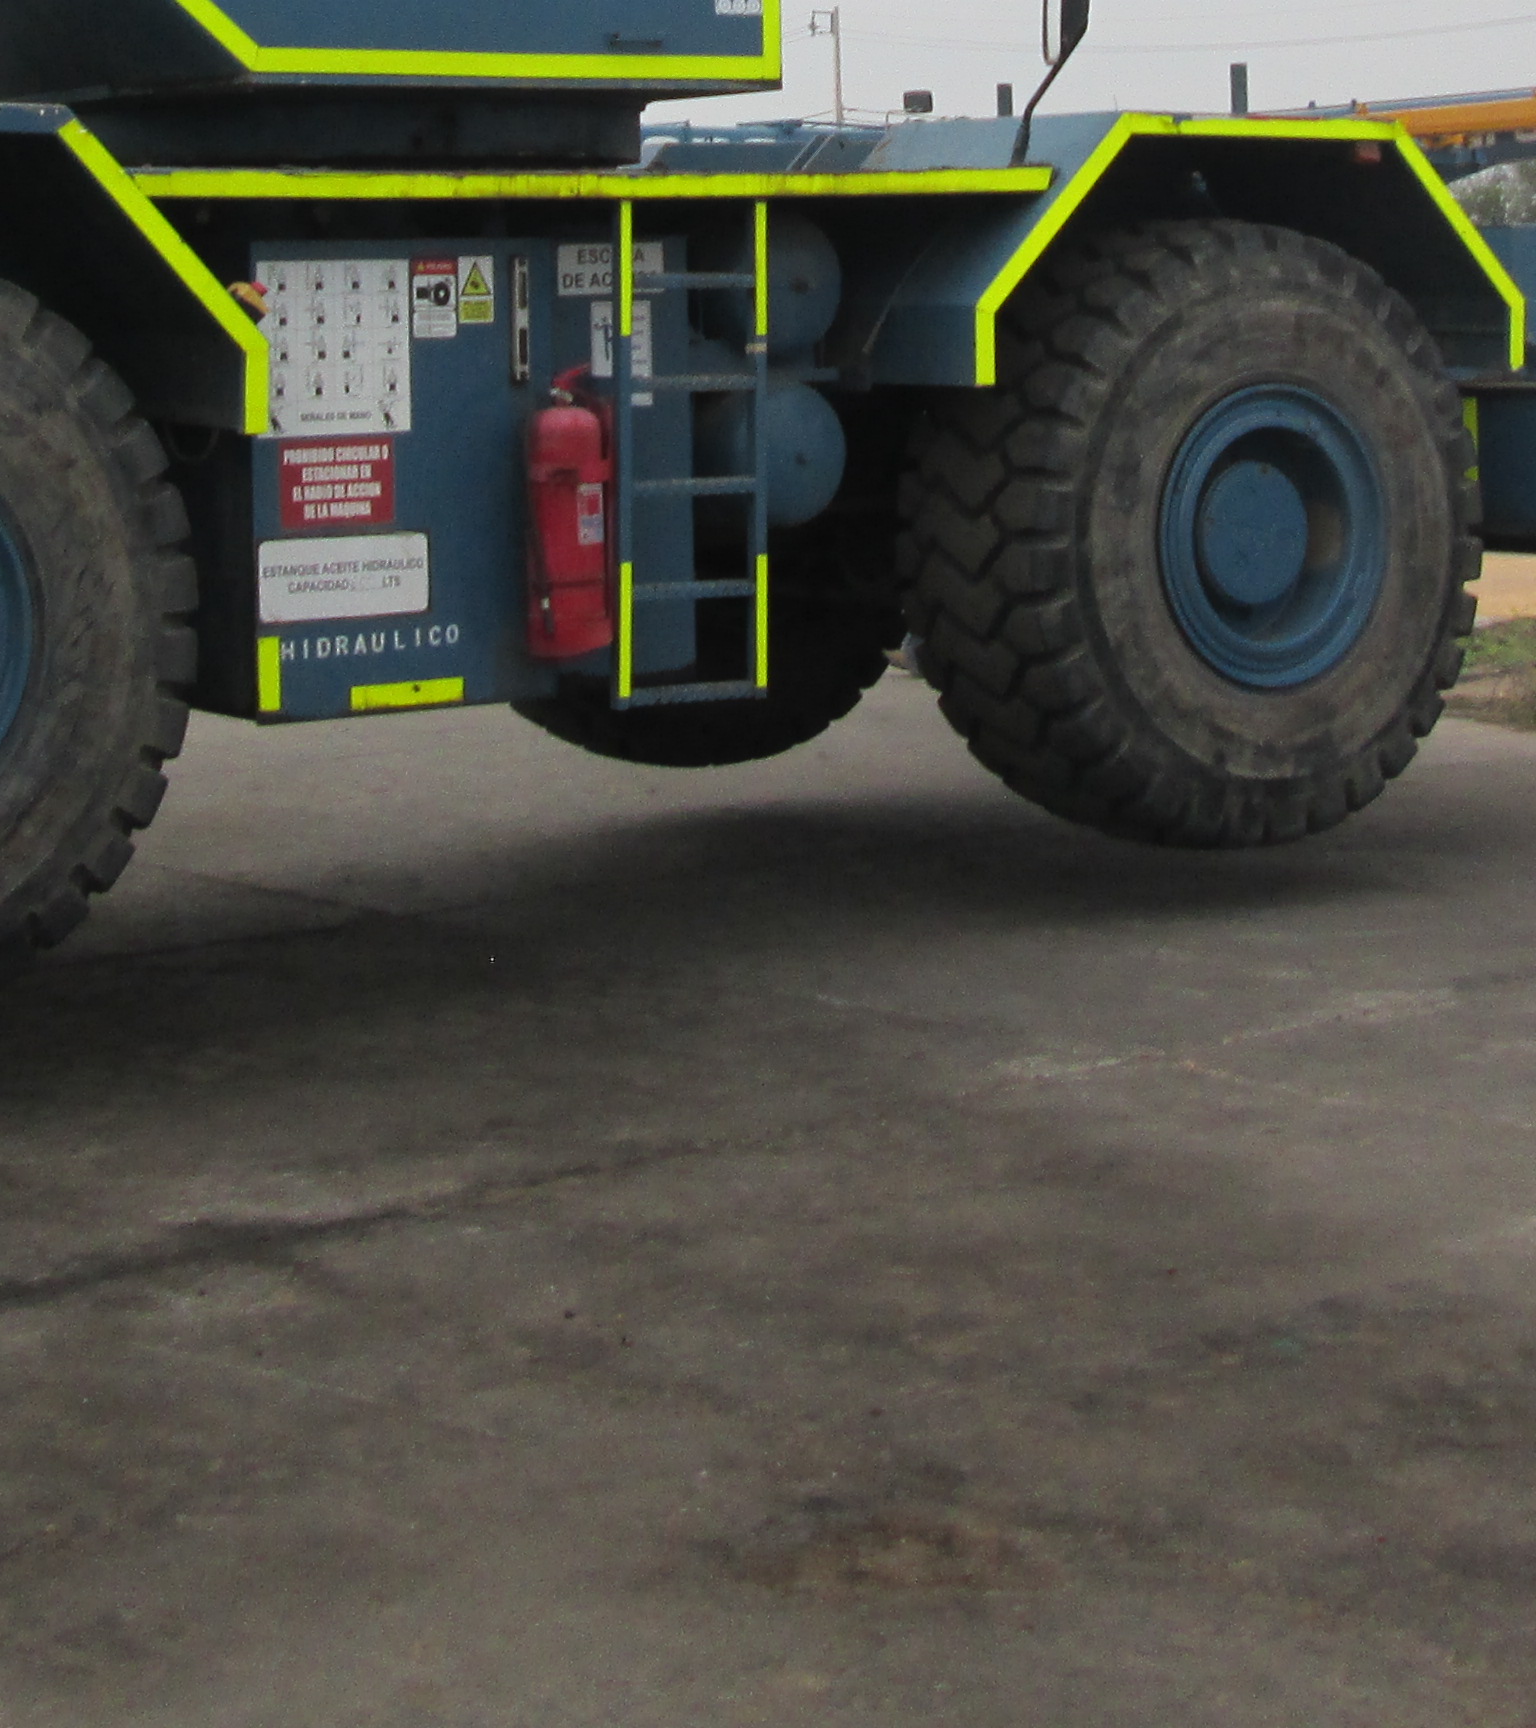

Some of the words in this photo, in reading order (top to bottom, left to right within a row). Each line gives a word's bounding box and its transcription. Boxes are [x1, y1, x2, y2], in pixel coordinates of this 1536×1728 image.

[577, 248, 645, 265] ESCA
[563, 273, 584, 289] DE
[281, 624, 460, 661] HIDRAULICO
